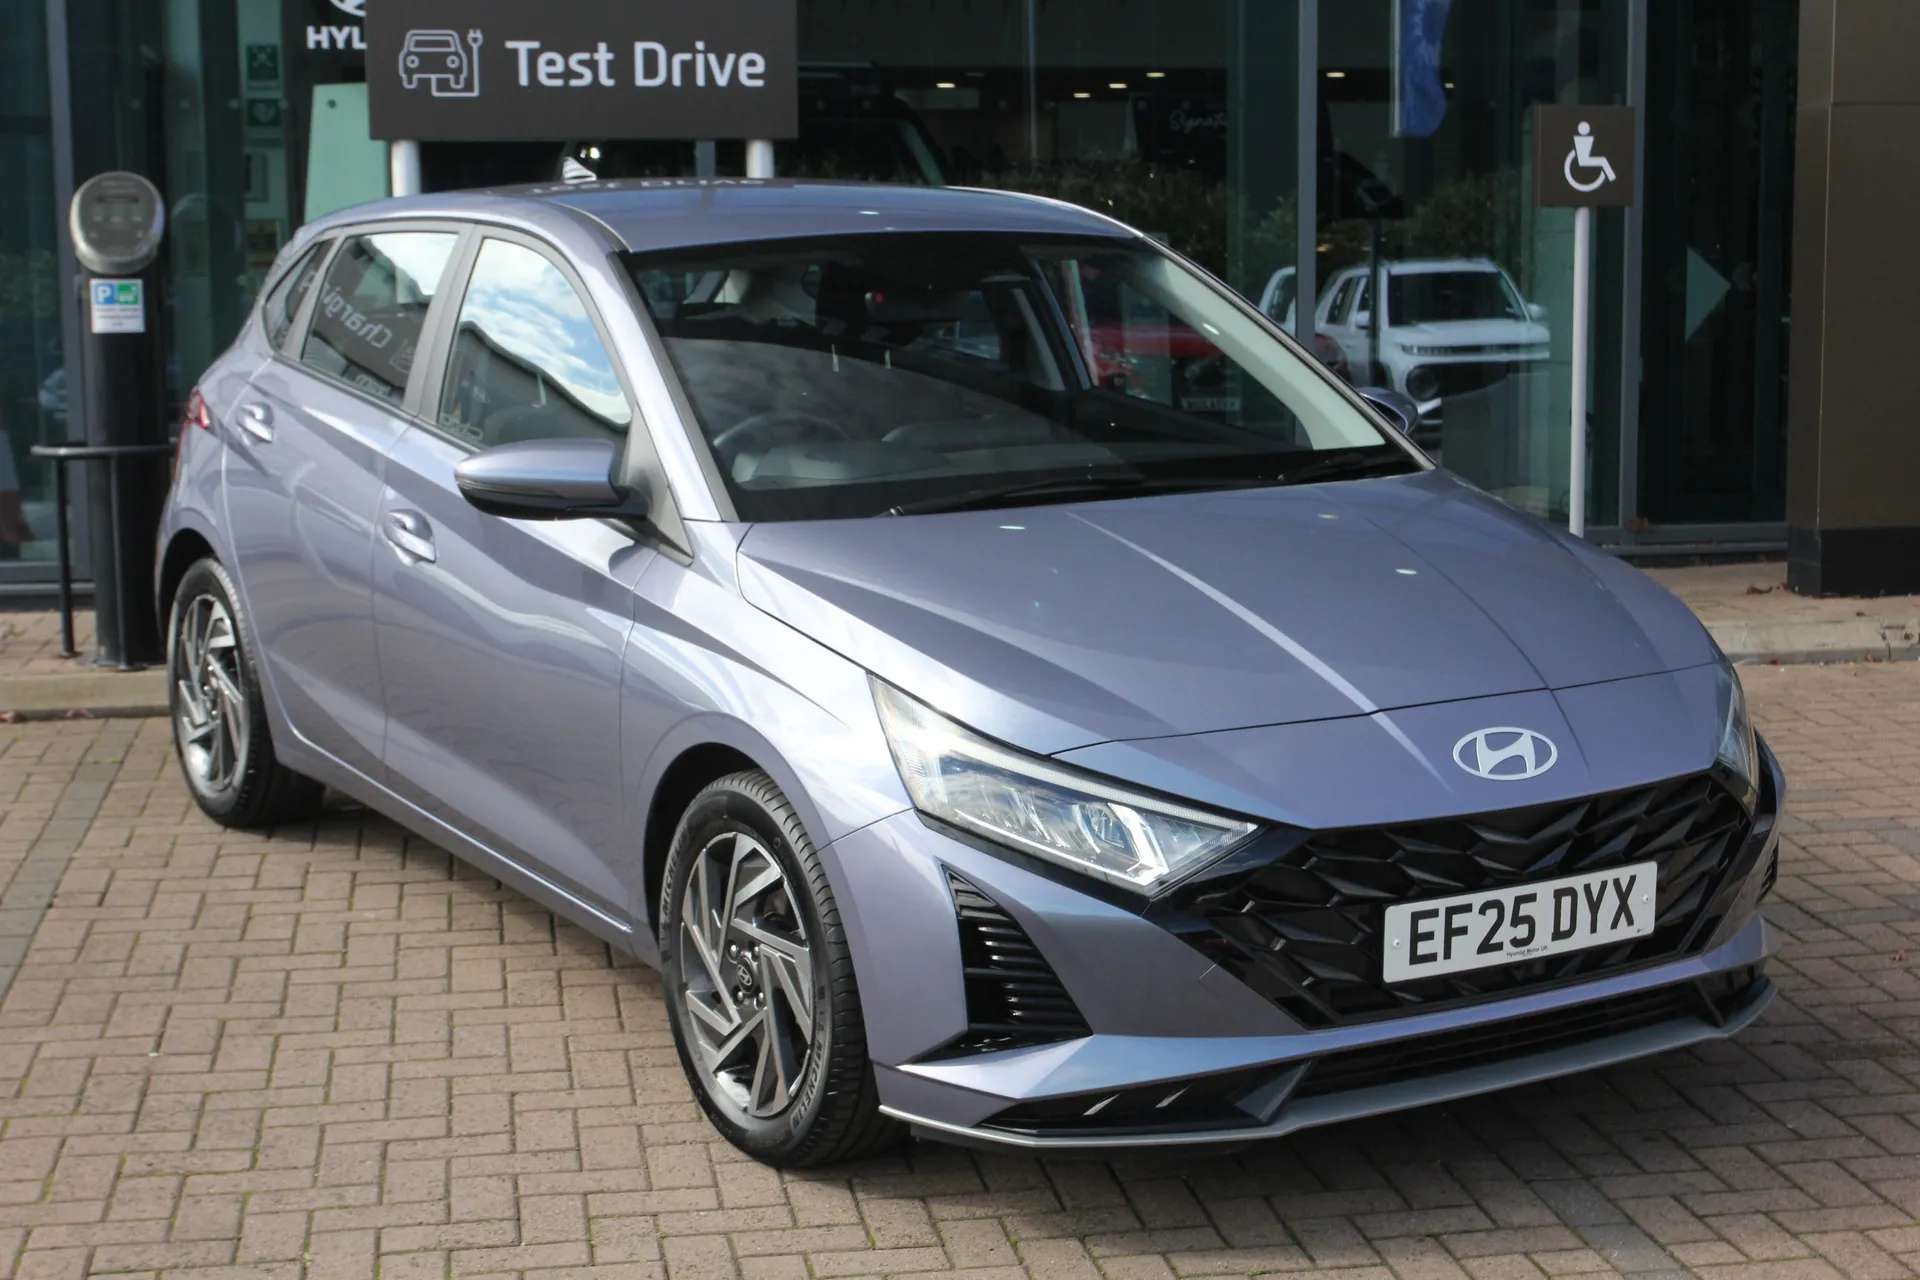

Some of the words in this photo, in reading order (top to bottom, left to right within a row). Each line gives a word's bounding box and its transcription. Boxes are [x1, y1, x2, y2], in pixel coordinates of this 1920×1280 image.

[505, 41, 615, 87] Test
[633, 41, 766, 87] Drive
[1409, 893, 1537, 965] EF25
[1551, 874, 1637, 941] DYX
